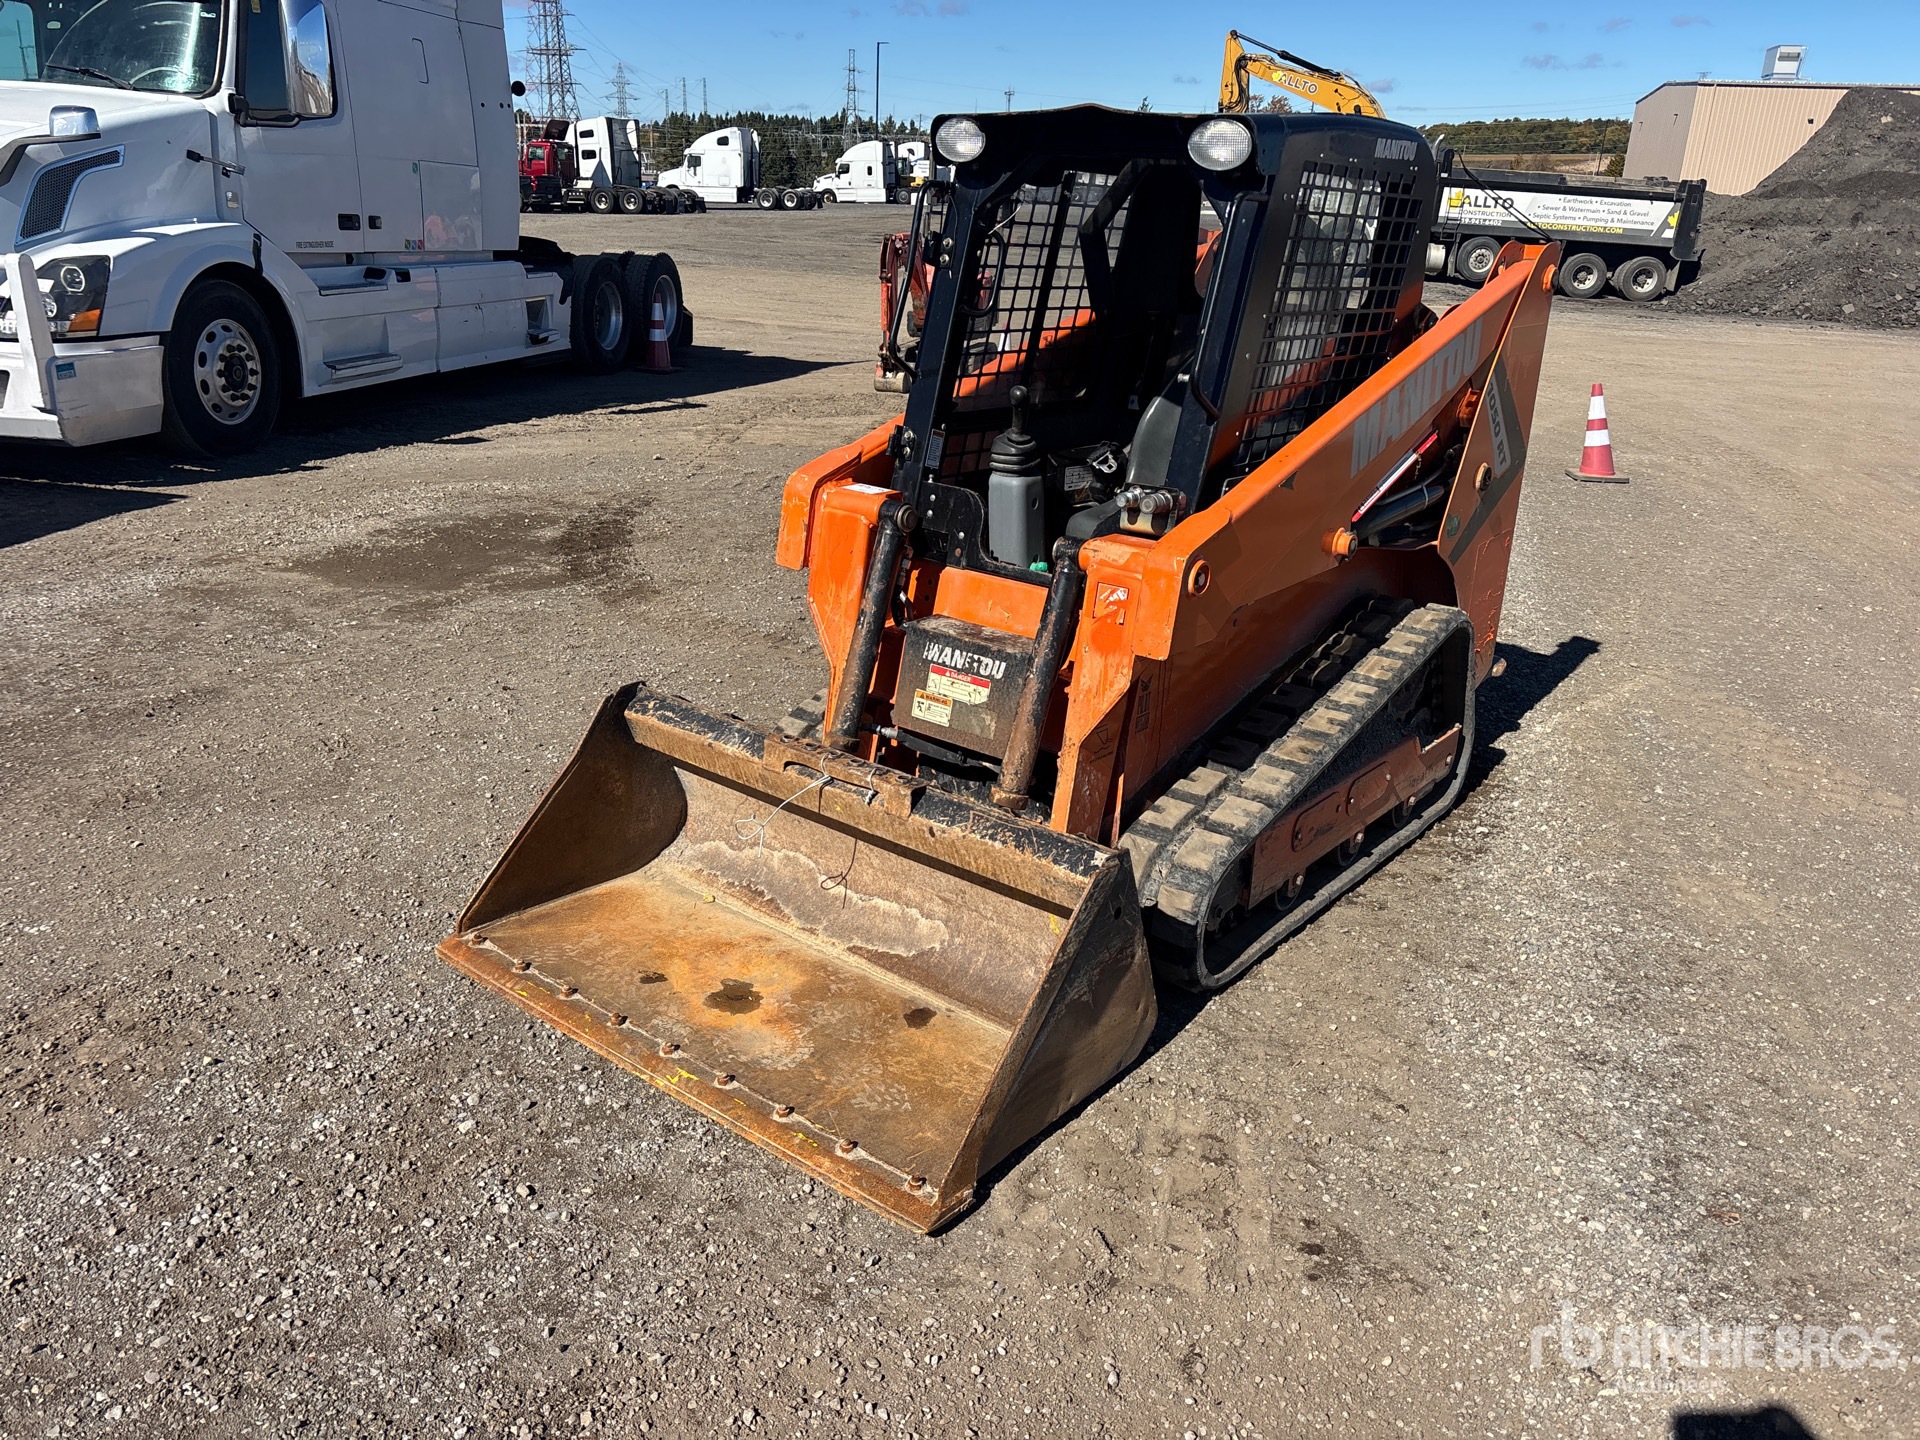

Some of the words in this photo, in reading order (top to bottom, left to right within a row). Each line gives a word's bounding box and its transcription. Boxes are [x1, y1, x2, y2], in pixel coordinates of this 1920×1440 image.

[1278, 72, 1317, 94] ALLTO
[1374, 137, 1418, 161] MANITOU
[1460, 194, 1514, 210] ALLTO
[1542, 204, 1561, 212] Sewer
[1568, 206, 1601, 214] Watermain
[1563, 197, 1594, 205] Earthwork
[1600, 199, 1632, 207] Excavation
[1457, 218, 1502, 226] 19-941-6402
[1532, 212, 1552, 220] Septic
[1552, 213, 1577, 222] Systems
[1582, 215, 1609, 224] Pumping
[1616, 218, 1655, 226] Maintenance
[1351, 315, 1482, 479] MANITOU
[1487, 382, 1501, 438] 1050
[1497, 439, 1507, 466] RT
